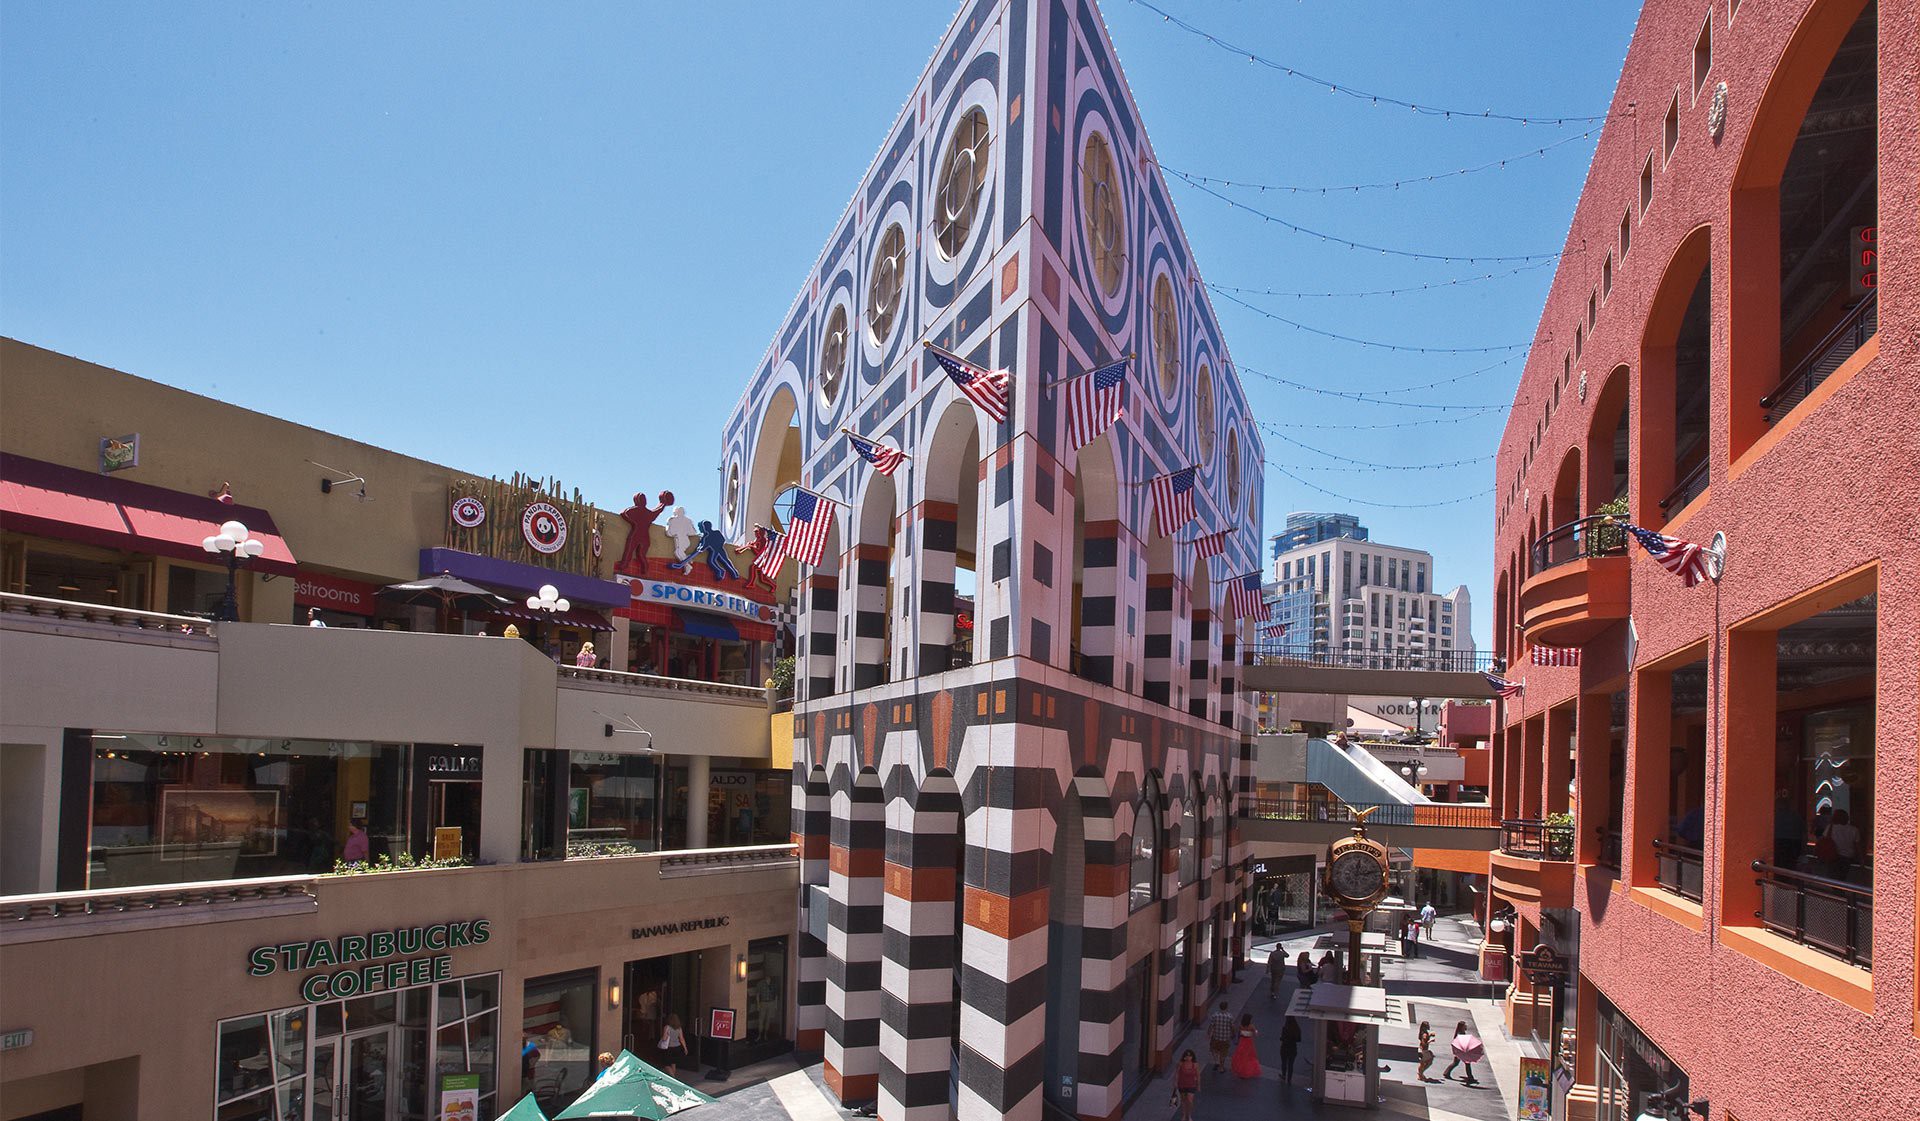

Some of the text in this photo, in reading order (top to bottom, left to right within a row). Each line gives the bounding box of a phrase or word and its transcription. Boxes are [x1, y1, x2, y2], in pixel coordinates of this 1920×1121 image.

[524, 504, 566, 531] PANDA EXPRESS
[652, 584, 759, 617] SPORTS FEVER
[1377, 705, 1441, 715] NORDTR
[711, 776, 747, 785] ALDO
[632, 916, 730, 940] BANANA REPUBLIC
[249, 920, 491, 977] STARBUCKS
[302, 956, 453, 1003] COFFEE
[4, 1033, 26, 1048] EXIT
